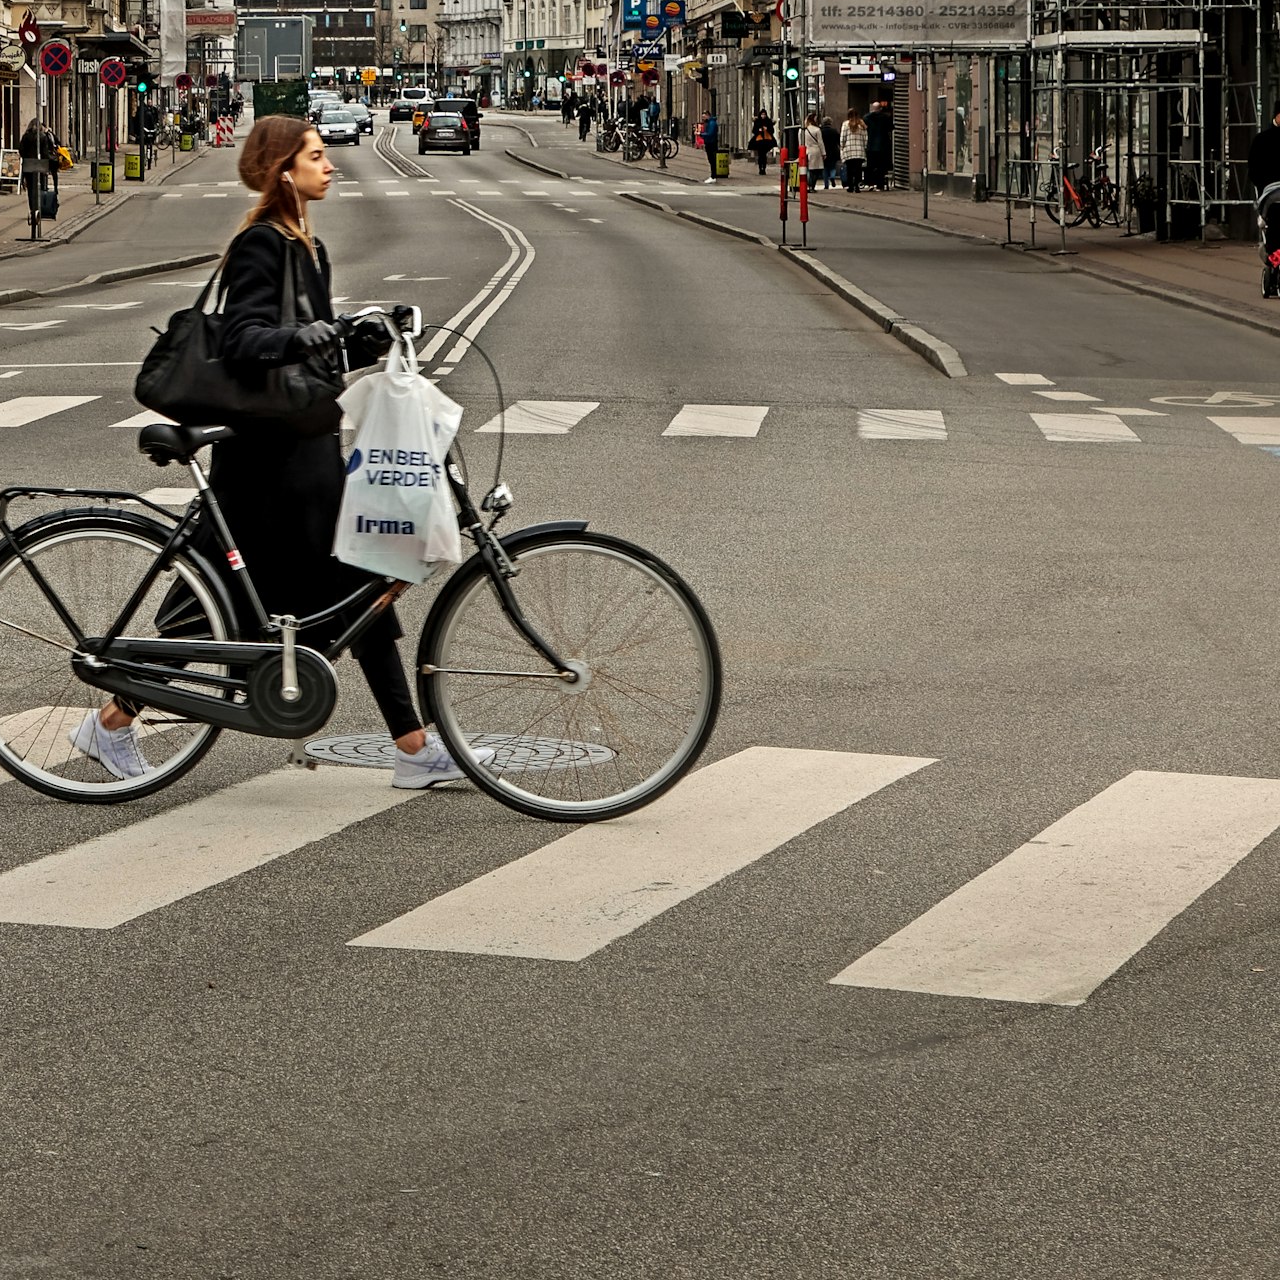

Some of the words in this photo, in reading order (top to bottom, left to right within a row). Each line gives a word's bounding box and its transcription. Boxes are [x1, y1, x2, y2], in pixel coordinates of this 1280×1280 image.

[821, 4, 842, 18] tlf:
[847, 5, 924, 18] 25214380
[939, 4, 1016, 17] 25214359
[368, 448, 394, 465] EN
[355, 515, 416, 535] Irma
